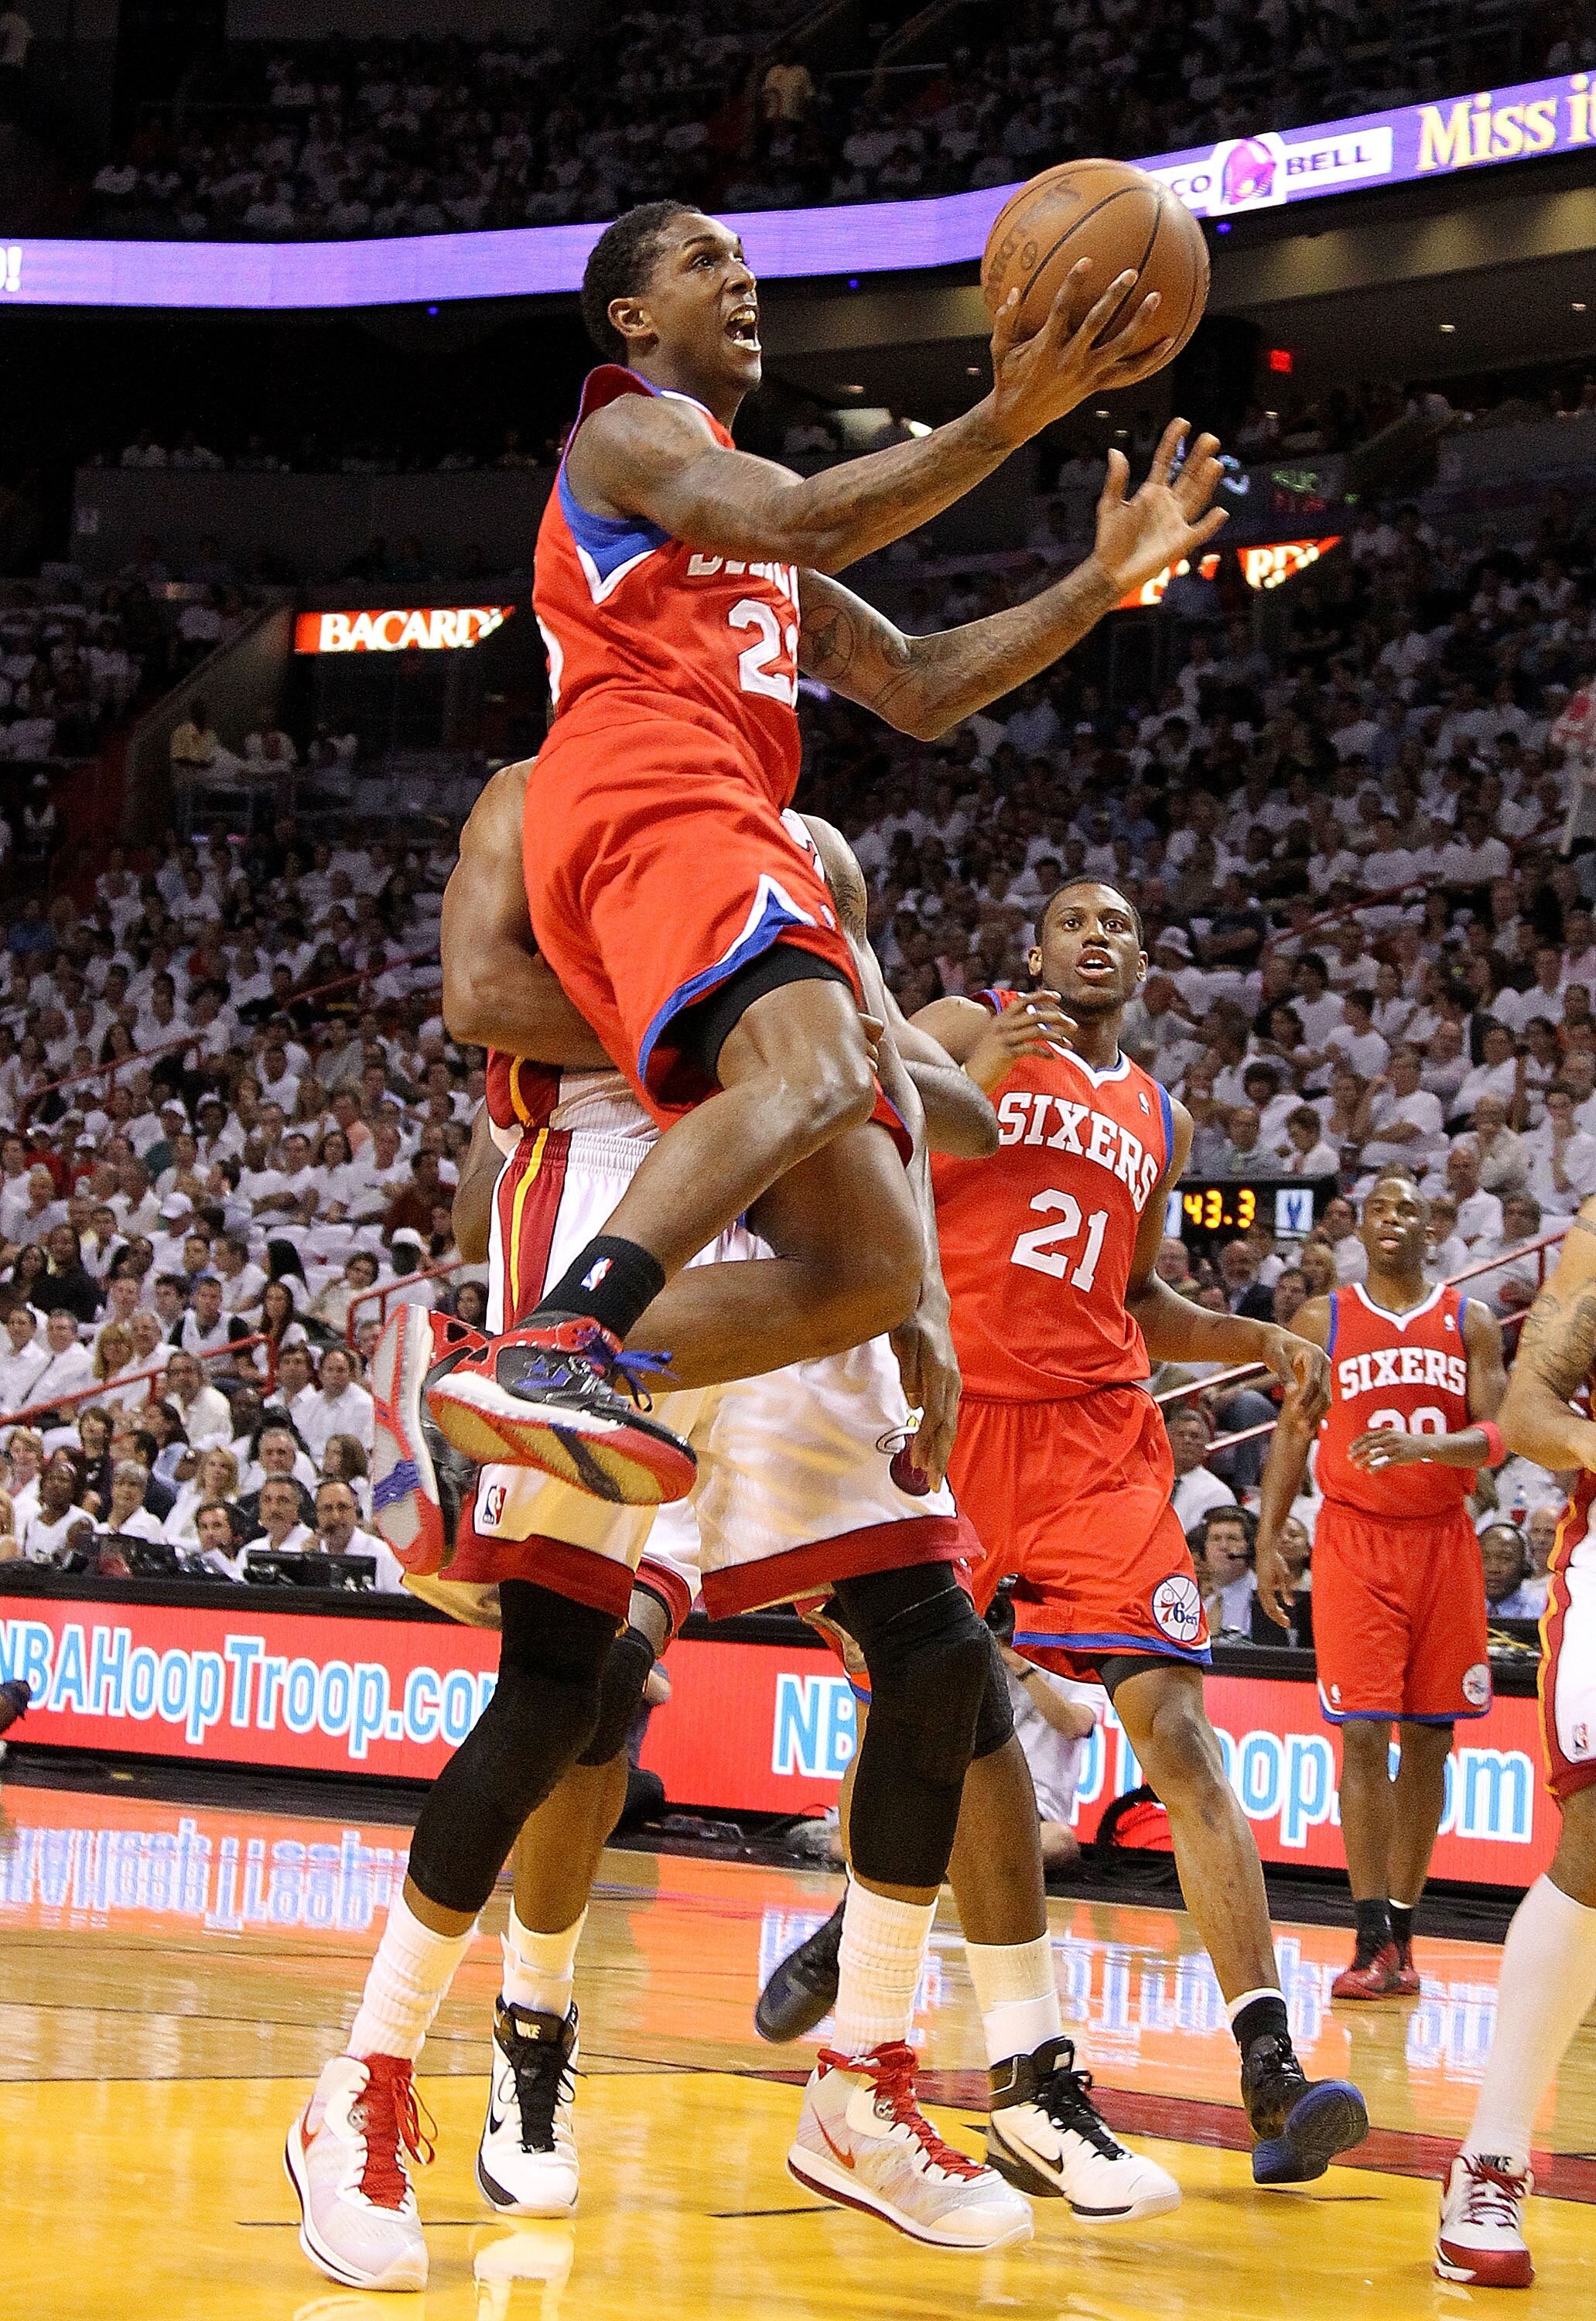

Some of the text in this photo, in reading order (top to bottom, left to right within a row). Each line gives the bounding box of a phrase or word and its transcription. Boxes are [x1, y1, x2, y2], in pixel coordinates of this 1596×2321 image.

[1417, 92, 1557, 172] Miss
[1171, 143, 1373, 197] CO BELL
[318, 607, 504, 651] BACARD
[996, 1091, 1159, 1213] SIXERS
[1010, 1188, 1109, 1294] 21
[1183, 1189, 1256, 1229] 43.3
[1338, 1347, 1467, 1400] SIXERS
[0, 1619, 499, 1759] NBAHoopTroop.co
